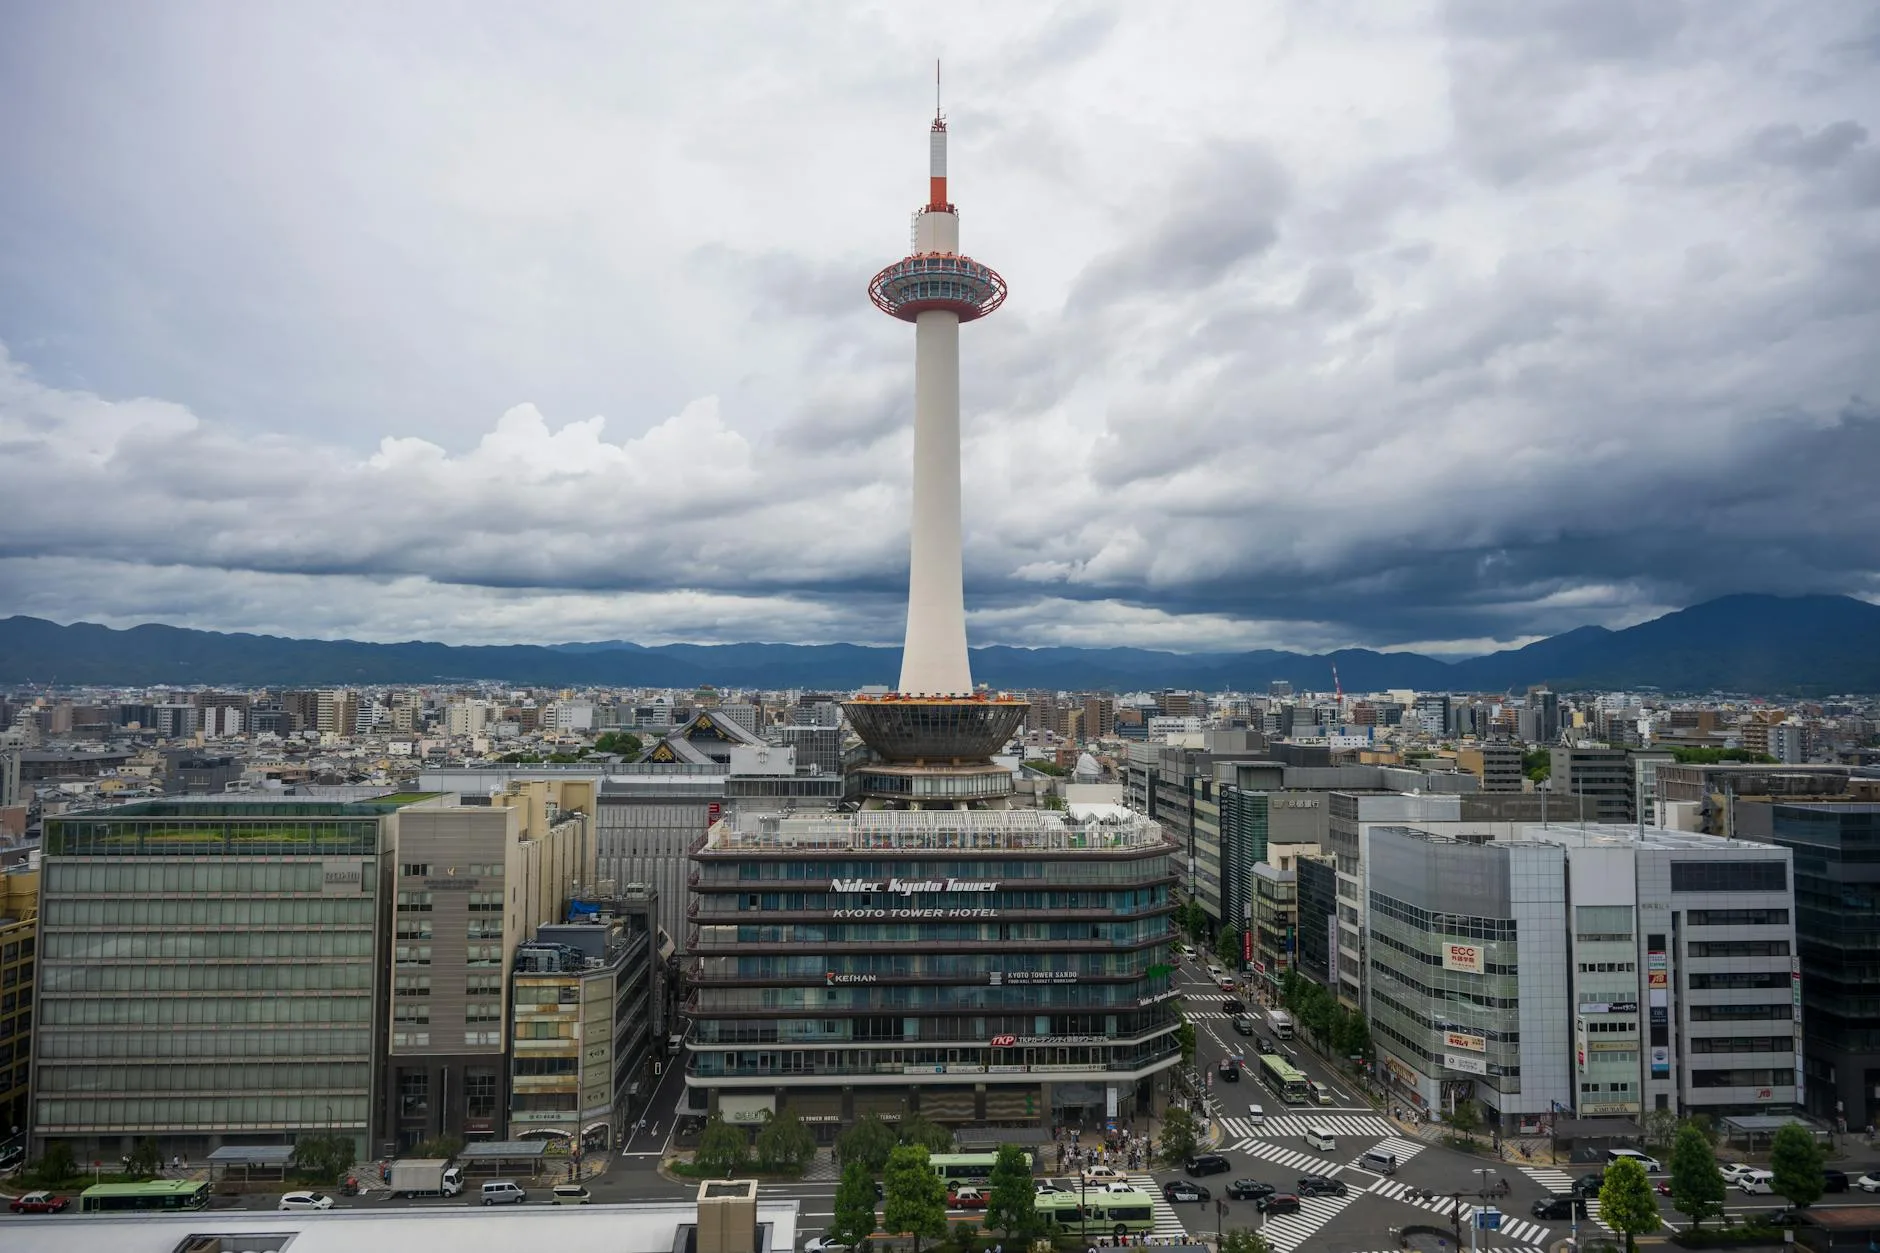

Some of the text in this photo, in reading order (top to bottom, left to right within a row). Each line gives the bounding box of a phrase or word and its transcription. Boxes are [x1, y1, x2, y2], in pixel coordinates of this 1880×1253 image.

[1288, 799, 1320, 808] 京都銀行
[829, 878, 1000, 896] Nidec Kyoto Tower
[833, 908, 998, 918] KYOTO TOWER HOTEL
[1451, 946, 1474, 957] ECC
[835, 974, 877, 982] KEIHAN
[992, 1036, 1015, 1045] TKP
[1449, 1038, 1468, 1047] キタムラ
[1758, 1088, 1771, 1098] JTB
